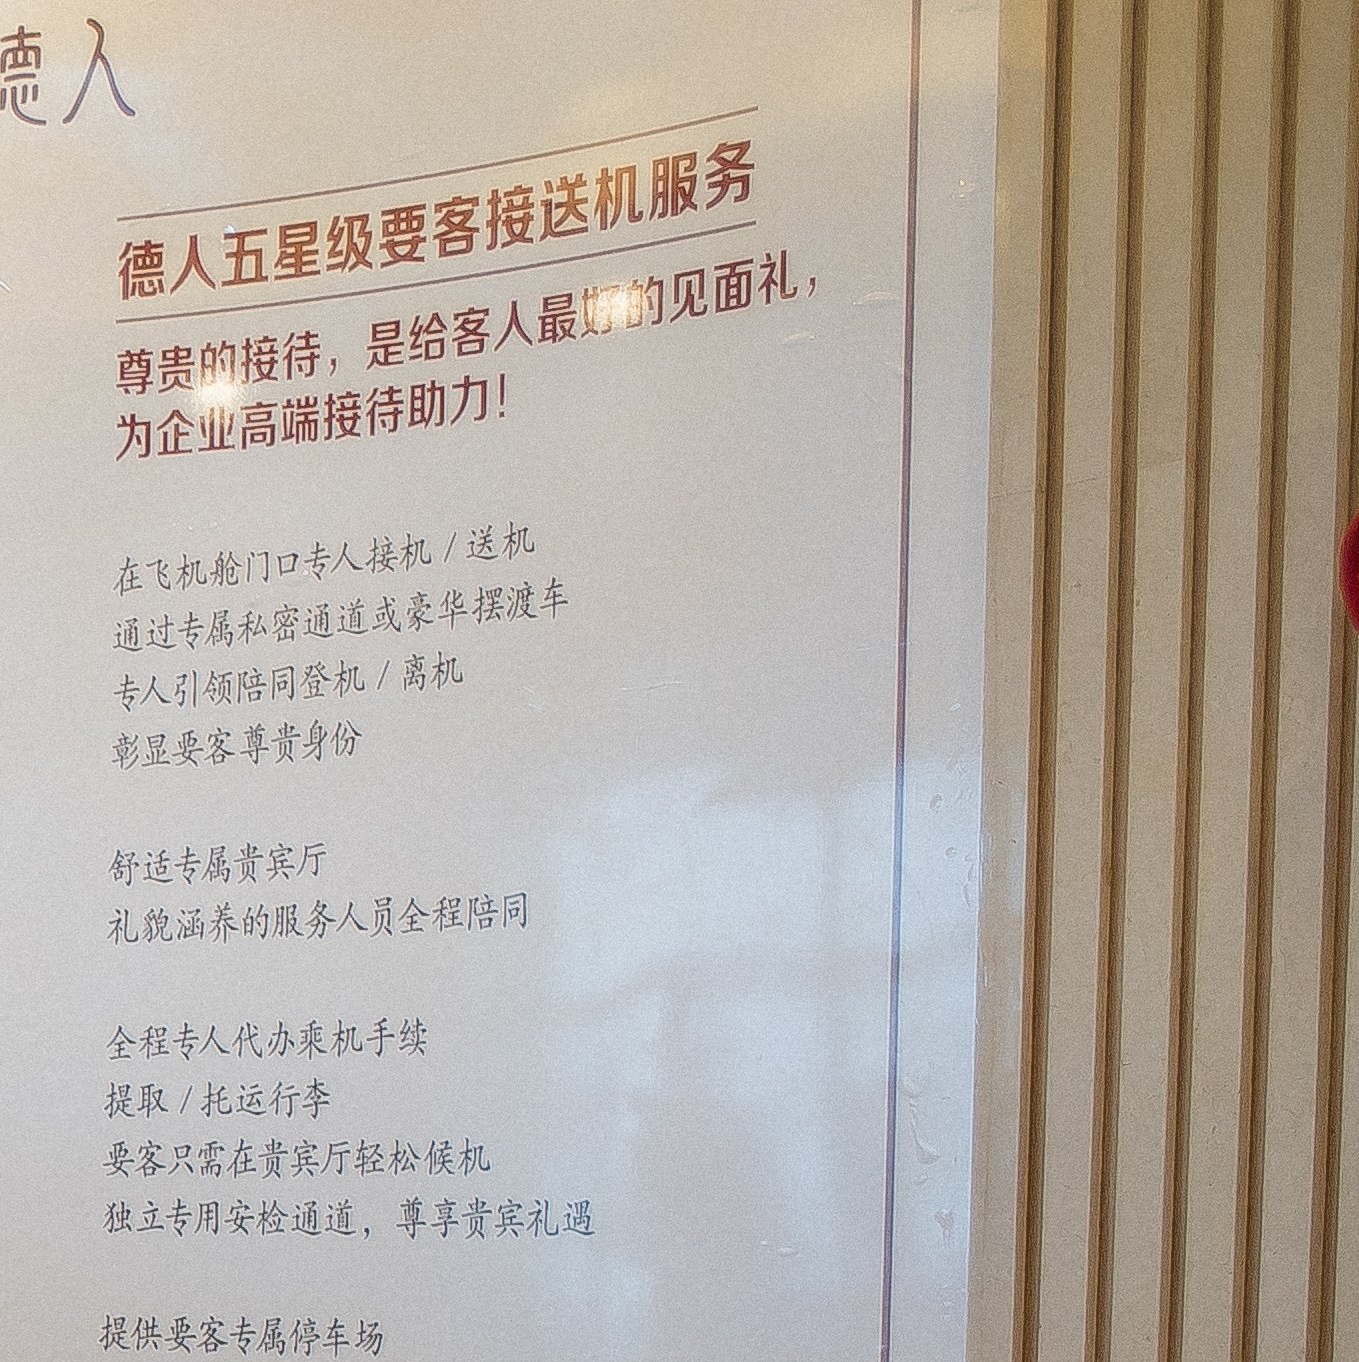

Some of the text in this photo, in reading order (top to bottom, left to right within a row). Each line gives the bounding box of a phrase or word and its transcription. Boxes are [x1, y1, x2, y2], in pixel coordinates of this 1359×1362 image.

[119, 139, 756, 301] 德人五星级要客接送机服务
[115, 373, 507, 462] 为企业高端接待助力！
[113, 531, 432, 596] 在飞机舱门口专人接机
[466, 521, 535, 562] 送机
[112, 576, 569, 654] 通过专属私密通道或豪华摆渡车
[112, 660, 365, 712] 专人引领陪同登机
[402, 650, 464, 693] 离机
[110, 718, 363, 770] 彰显要客尊贵身份
[109, 842, 327, 888] 舒适专属贵宾厅
[108, 891, 528, 946] 礼貌涵养的服务人员全程陪同
[106, 1017, 428, 1061] 全程专人代办乘机手续
[104, 1082, 169, 1120] 提取
[200, 1077, 330, 1121] 托运行李
[103, 1138, 492, 1179] 要客只需在贵宾厅轻松候机
[102, 1197, 596, 1240] 独立专用安检通道，尊享贵宾礼遇
[99, 1315, 384, 1358] 提供要客专属停车场
